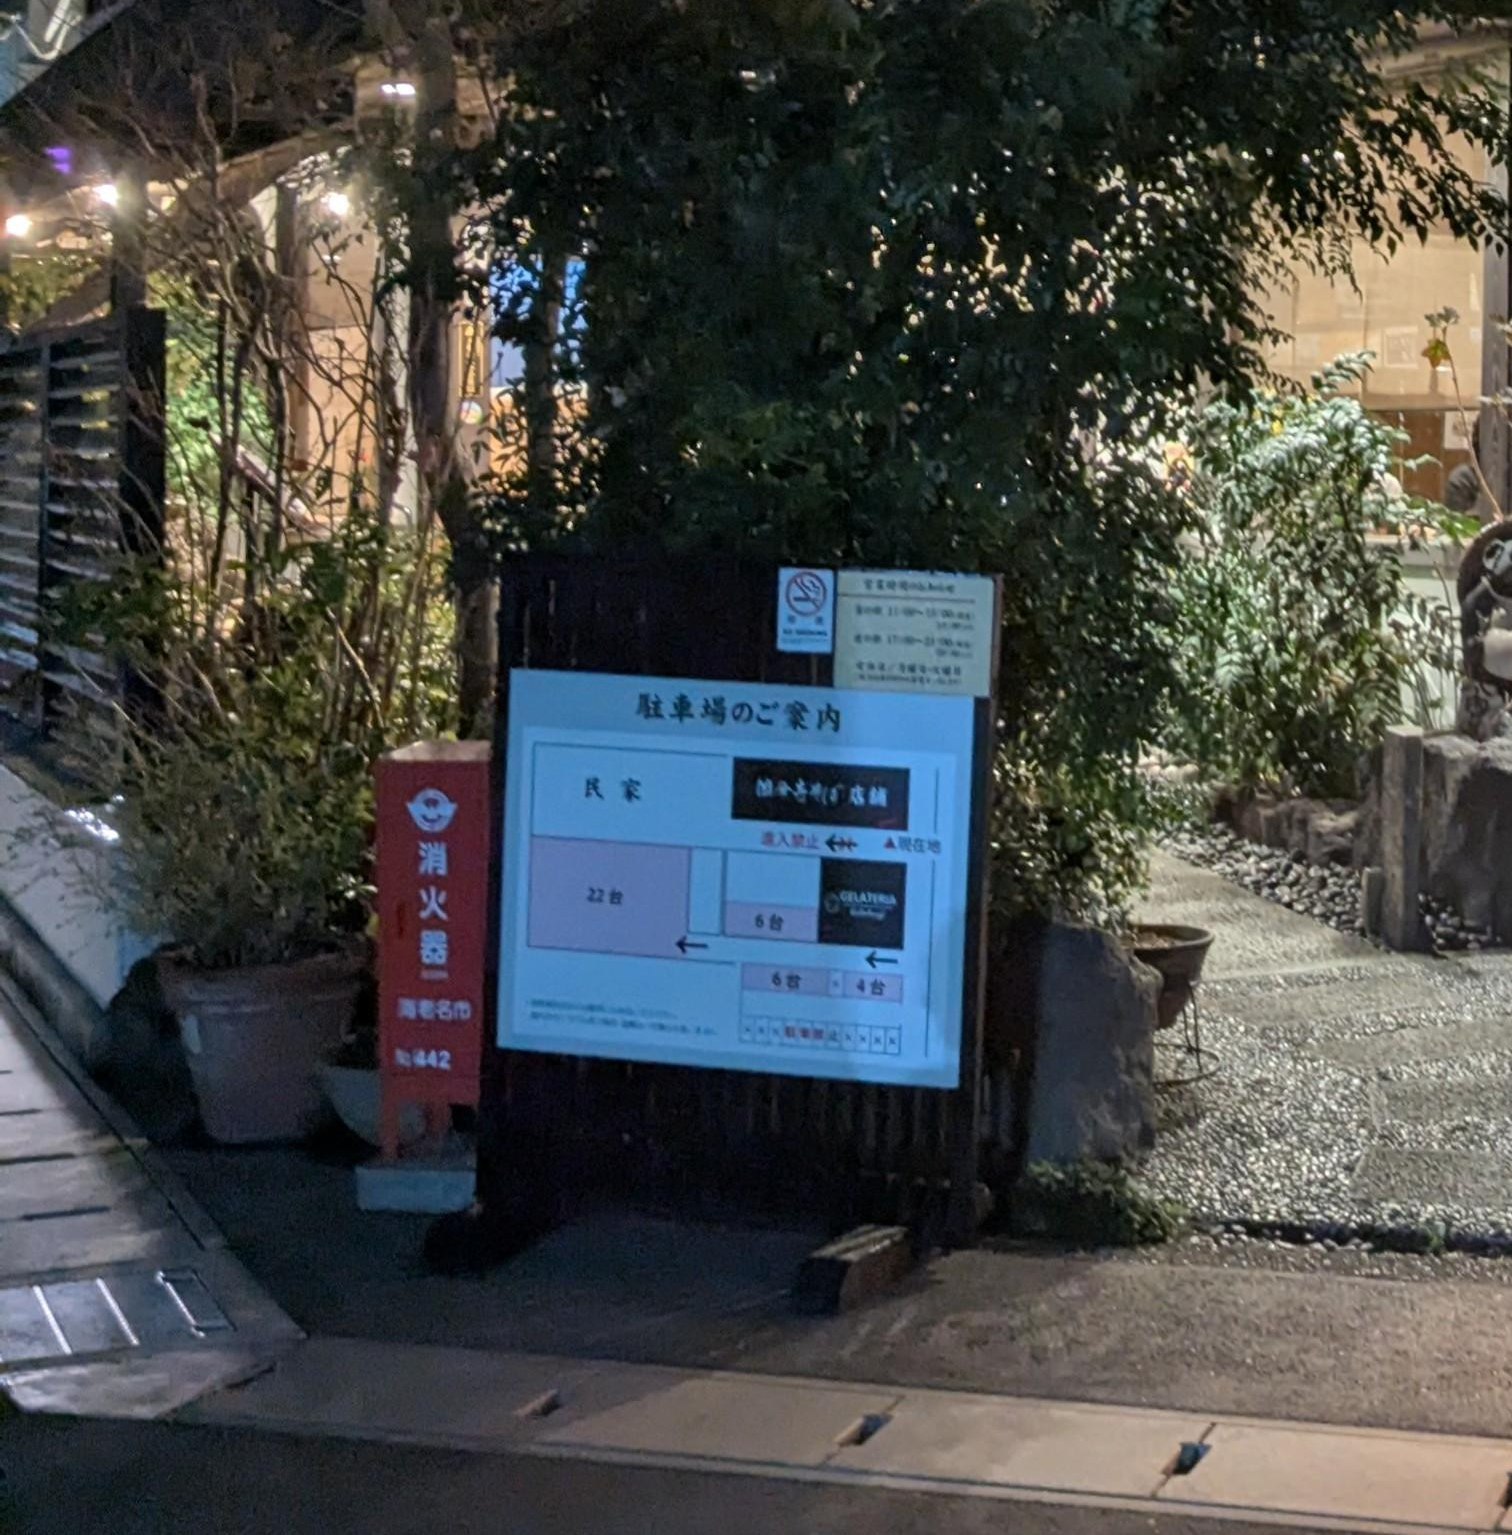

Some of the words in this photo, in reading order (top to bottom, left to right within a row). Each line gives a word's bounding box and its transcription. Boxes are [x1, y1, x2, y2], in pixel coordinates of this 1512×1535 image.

[636, 692, 841, 733] 駐車場のご案内
[584, 776, 642, 803] 民家
[851, 784, 888, 808] 店舗
[898, 837, 942, 854] 現在地
[418, 841, 448, 964] 消火器
